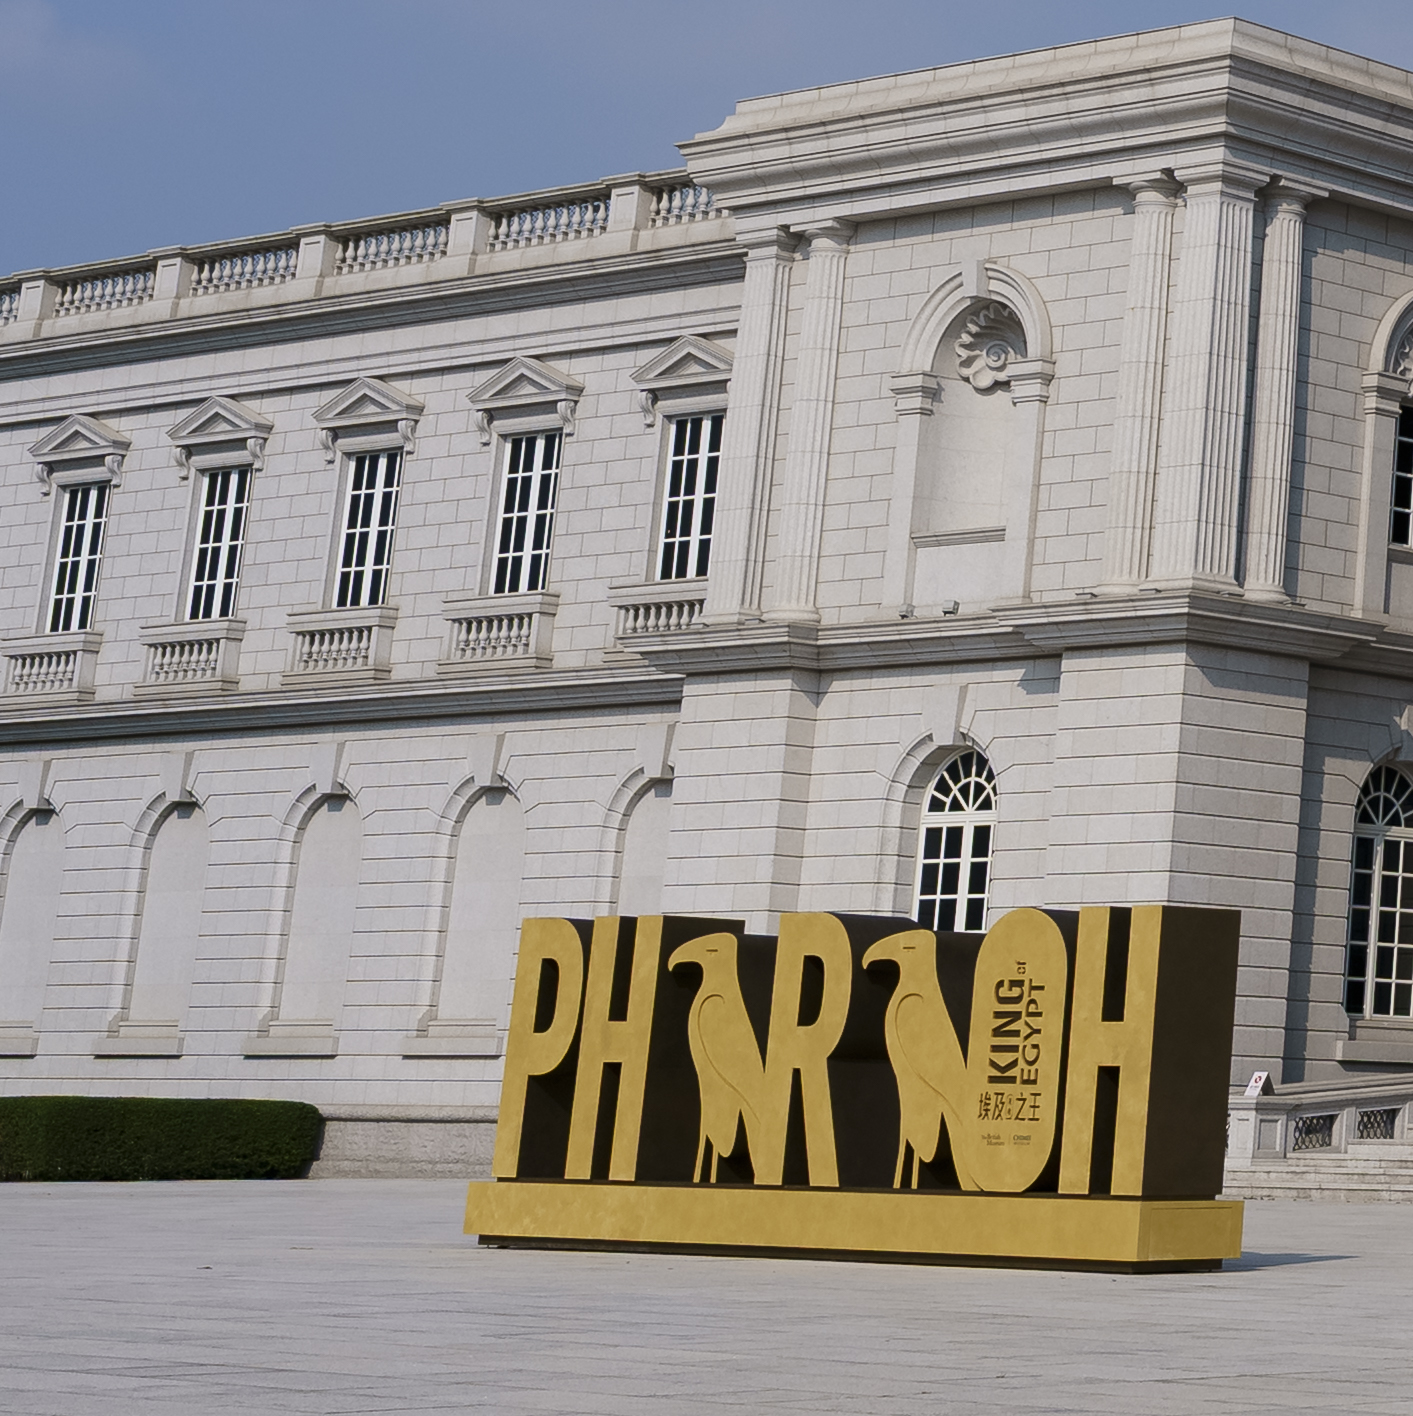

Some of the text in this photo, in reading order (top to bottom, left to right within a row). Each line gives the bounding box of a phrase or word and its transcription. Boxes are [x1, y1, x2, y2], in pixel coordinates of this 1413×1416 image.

[987, 979, 1026, 1085] KING
[1020, 977, 1046, 1085] EGYPT
[977, 1091, 1042, 1122] 埃及之王
